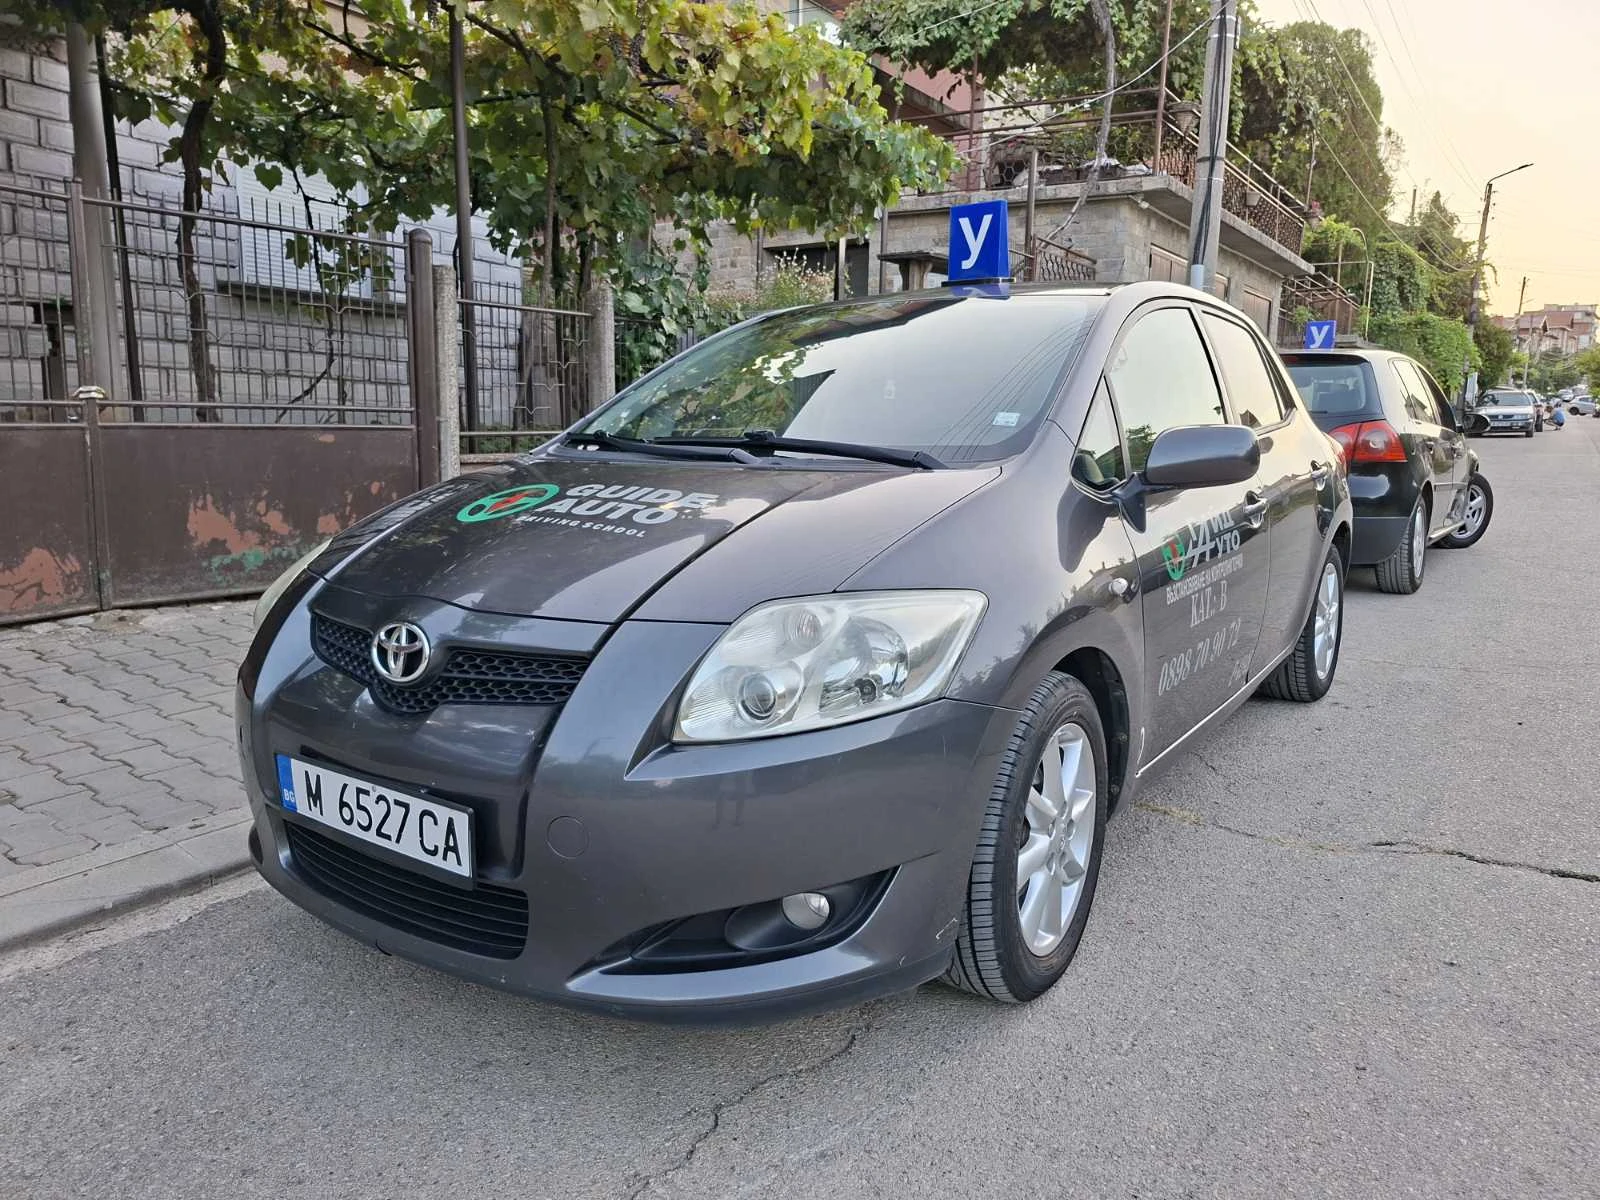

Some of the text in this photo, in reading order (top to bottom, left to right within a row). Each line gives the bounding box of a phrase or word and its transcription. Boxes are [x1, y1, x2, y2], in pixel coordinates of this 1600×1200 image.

[565, 484, 720, 509] GUIDE
[533, 498, 678, 524] AUTO
[581, 521, 646, 538] SCHOOL
[283, 788, 296, 802] BG
[304, 770, 463, 867] M 6527 CA
